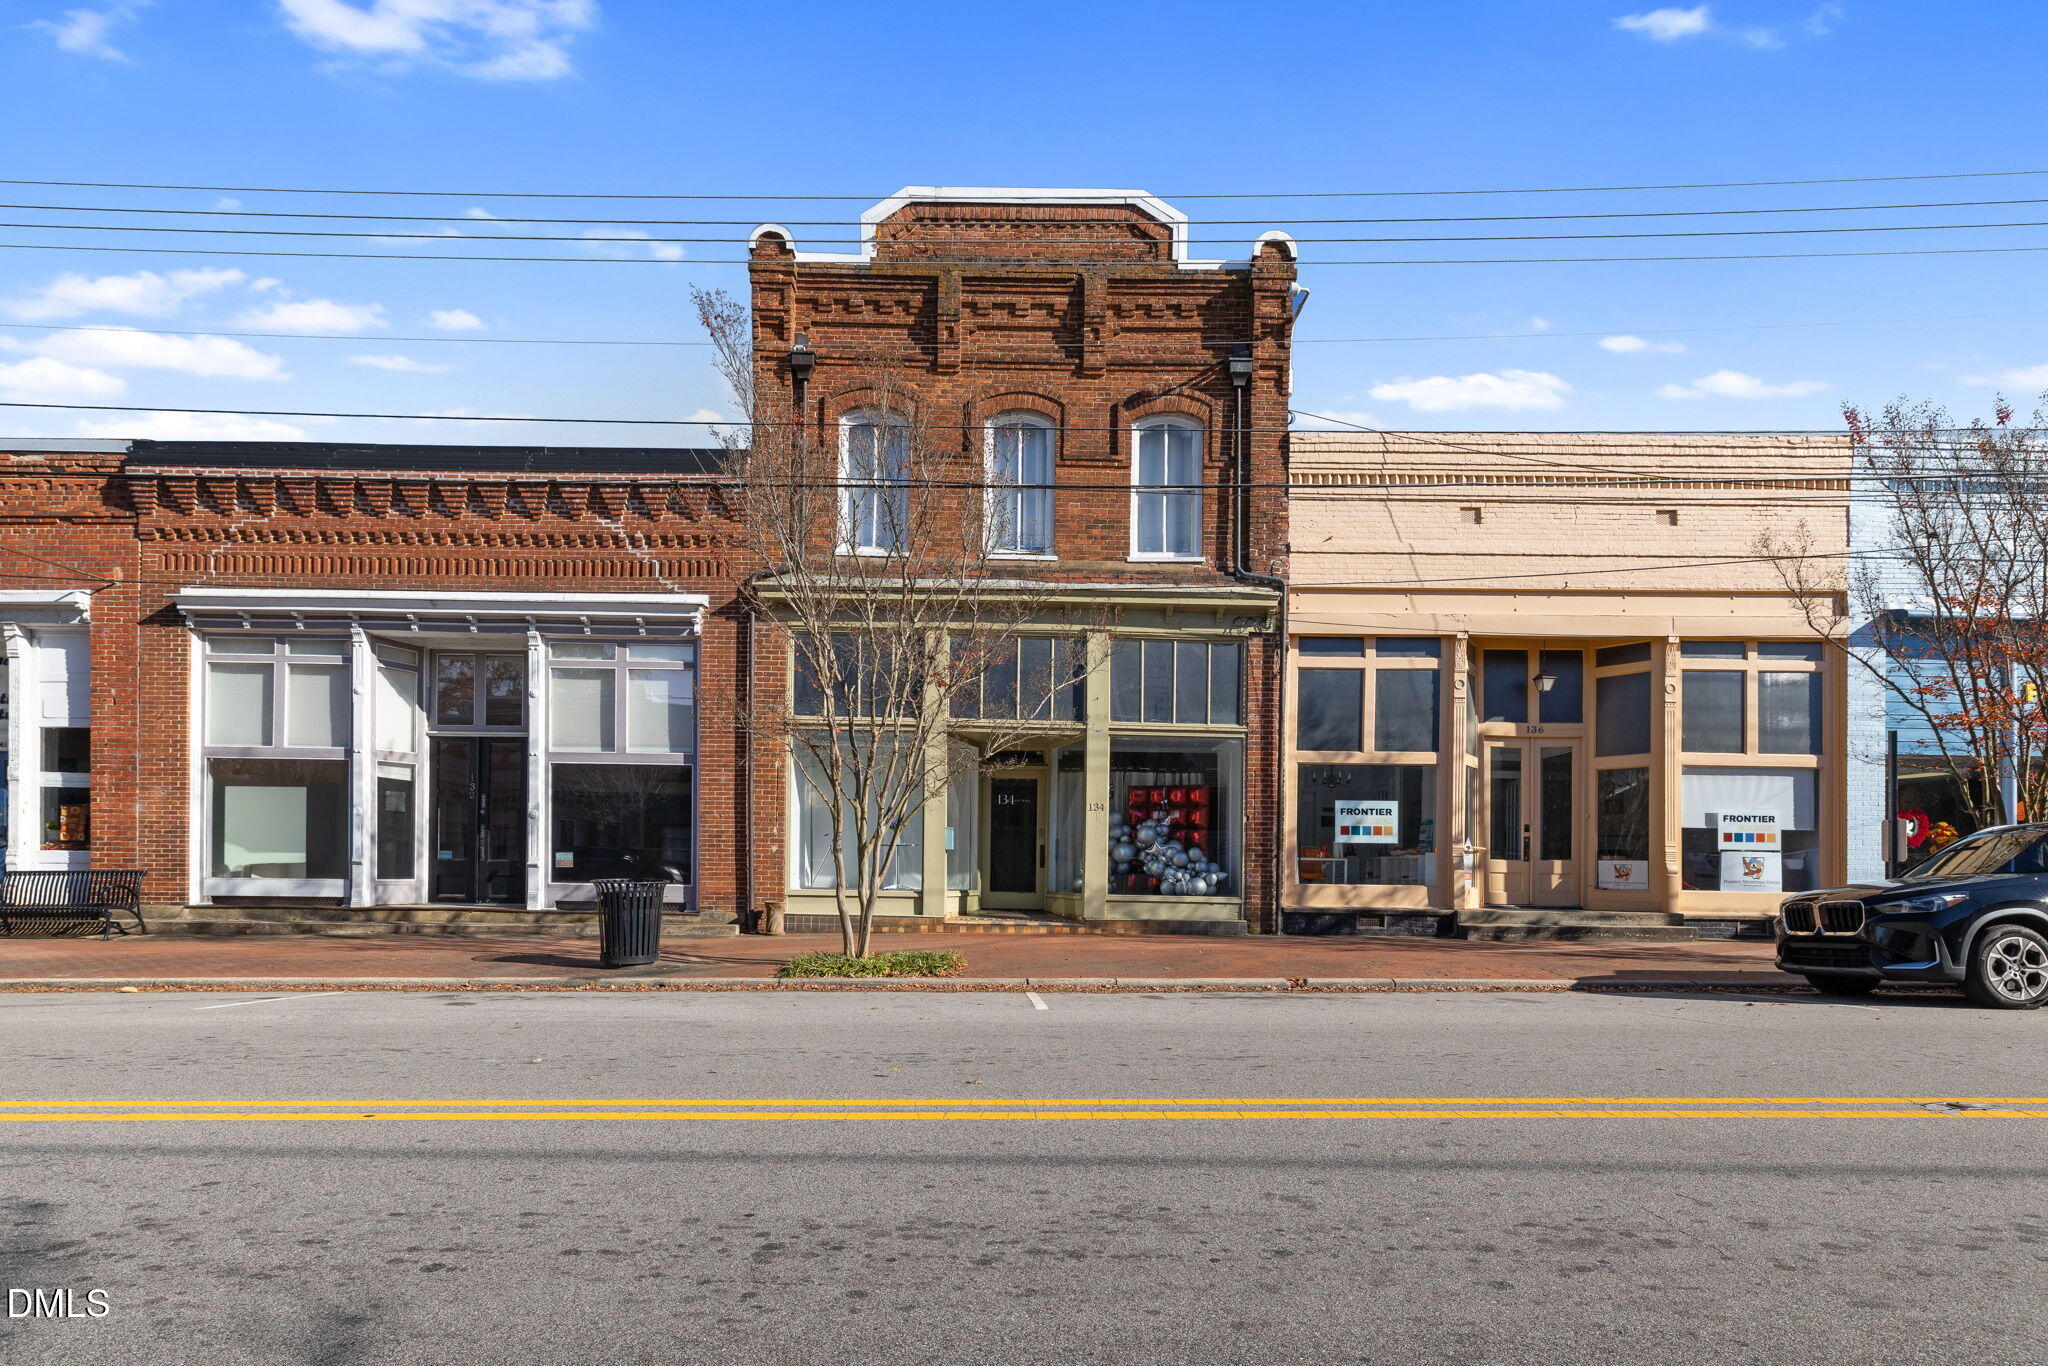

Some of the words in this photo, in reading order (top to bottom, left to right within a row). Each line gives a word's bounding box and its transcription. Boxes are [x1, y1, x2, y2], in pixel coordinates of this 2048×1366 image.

[1526, 725, 1545, 734] 136
[998, 794, 1014, 805] 134
[1088, 803, 1105, 812] 134
[1340, 807, 1393, 816] FRONTIER
[1723, 814, 1776, 823] FRONTIER
